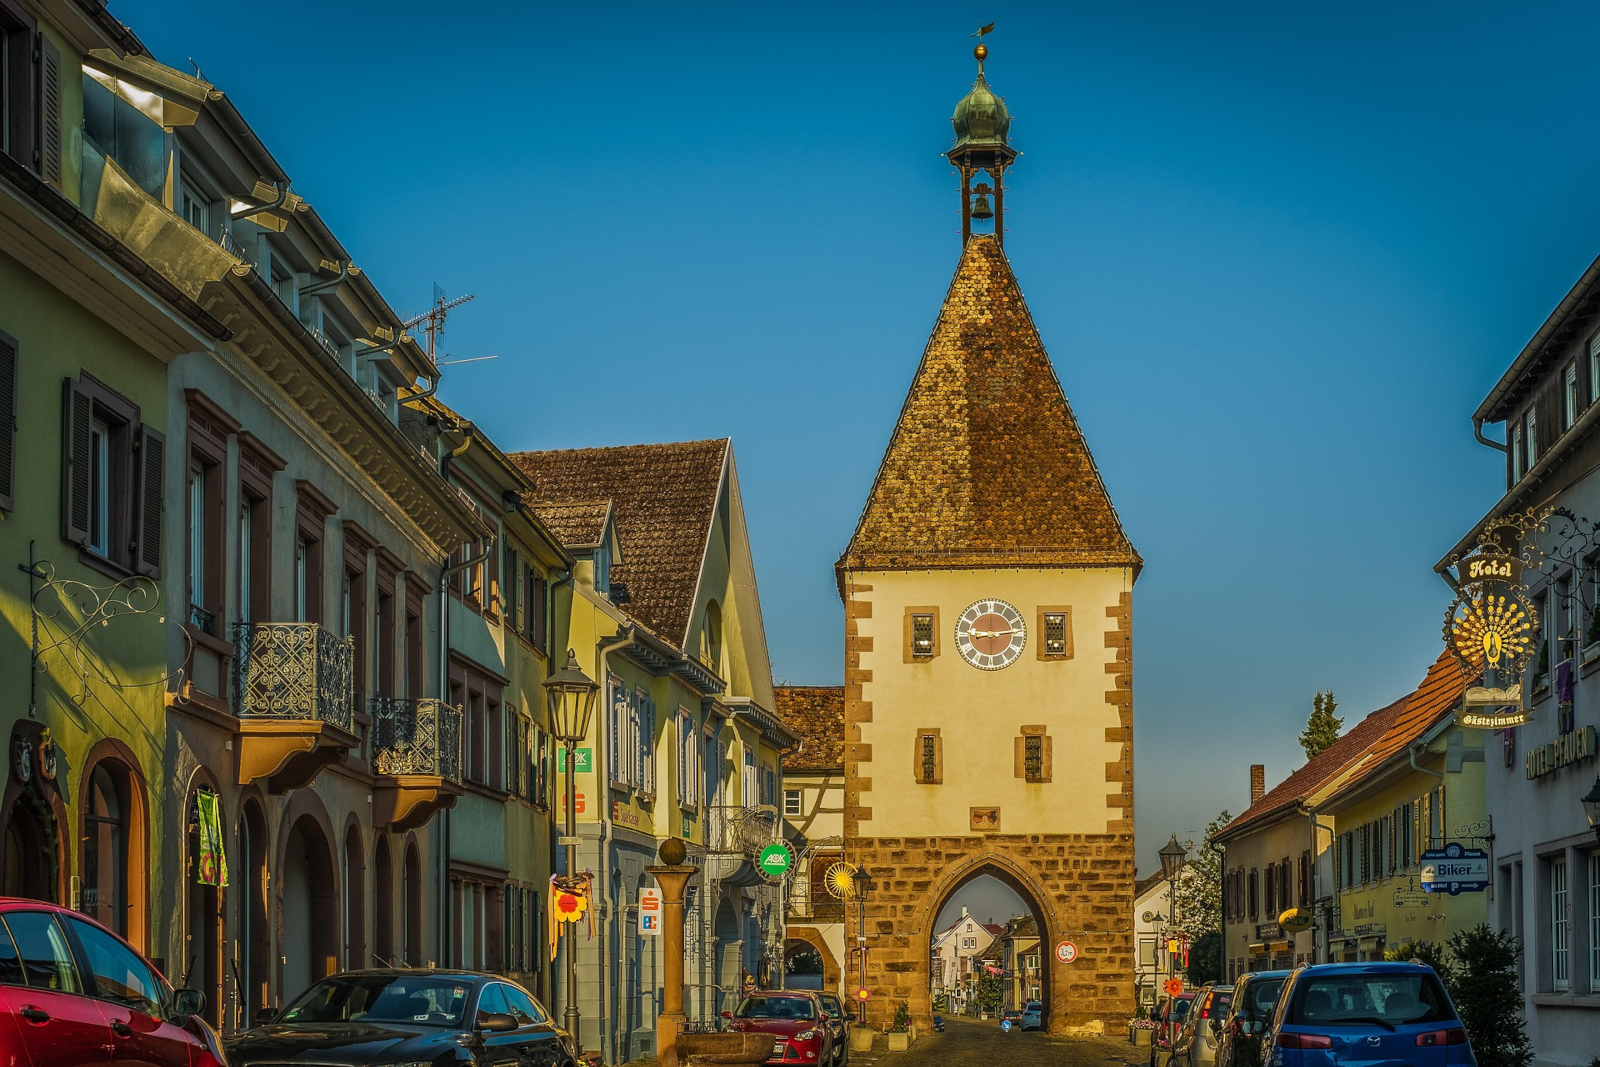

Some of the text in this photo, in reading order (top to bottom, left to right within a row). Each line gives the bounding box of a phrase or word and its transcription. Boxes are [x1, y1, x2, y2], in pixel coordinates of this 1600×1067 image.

[1469, 560, 1512, 578] Hotel
[1463, 715, 1524, 727] Gästezimmer
[562, 752, 587, 763] OK
[1526, 726, 1588, 779] HOTEL PFAUEN
[620, 808, 639, 826] Sparkasse
[764, 853, 786, 864] AOK
[1438, 863, 1472, 876] Biker
